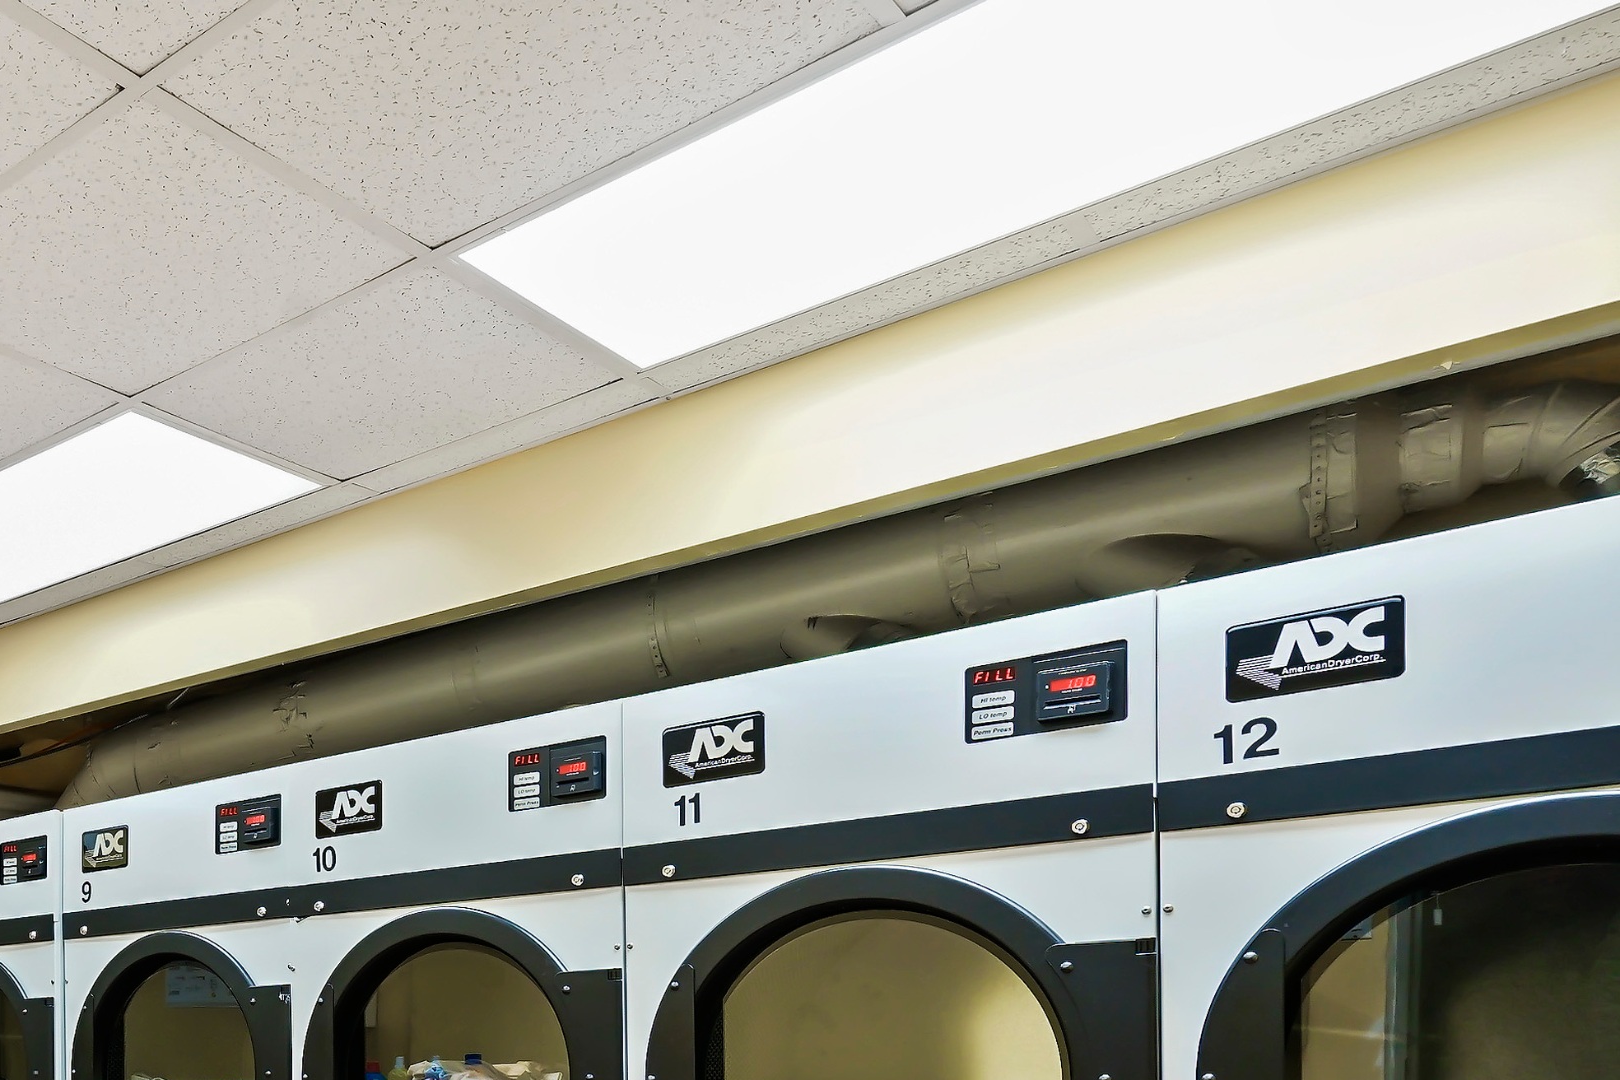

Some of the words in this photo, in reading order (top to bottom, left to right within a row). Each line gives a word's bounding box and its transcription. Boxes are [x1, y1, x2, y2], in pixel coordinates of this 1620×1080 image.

[1269, 606, 1385, 668] ADC
[974, 668, 1014, 684] FILL
[687, 718, 755, 763] ADC
[1213, 717, 1280, 764] 12
[515, 754, 540, 765] FILL
[331, 785, 376, 820] ADC
[674, 792, 700, 827] 11
[92, 829, 124, 858] ADC
[312, 845, 337, 873] 10
[81, 881, 92, 903] 9
